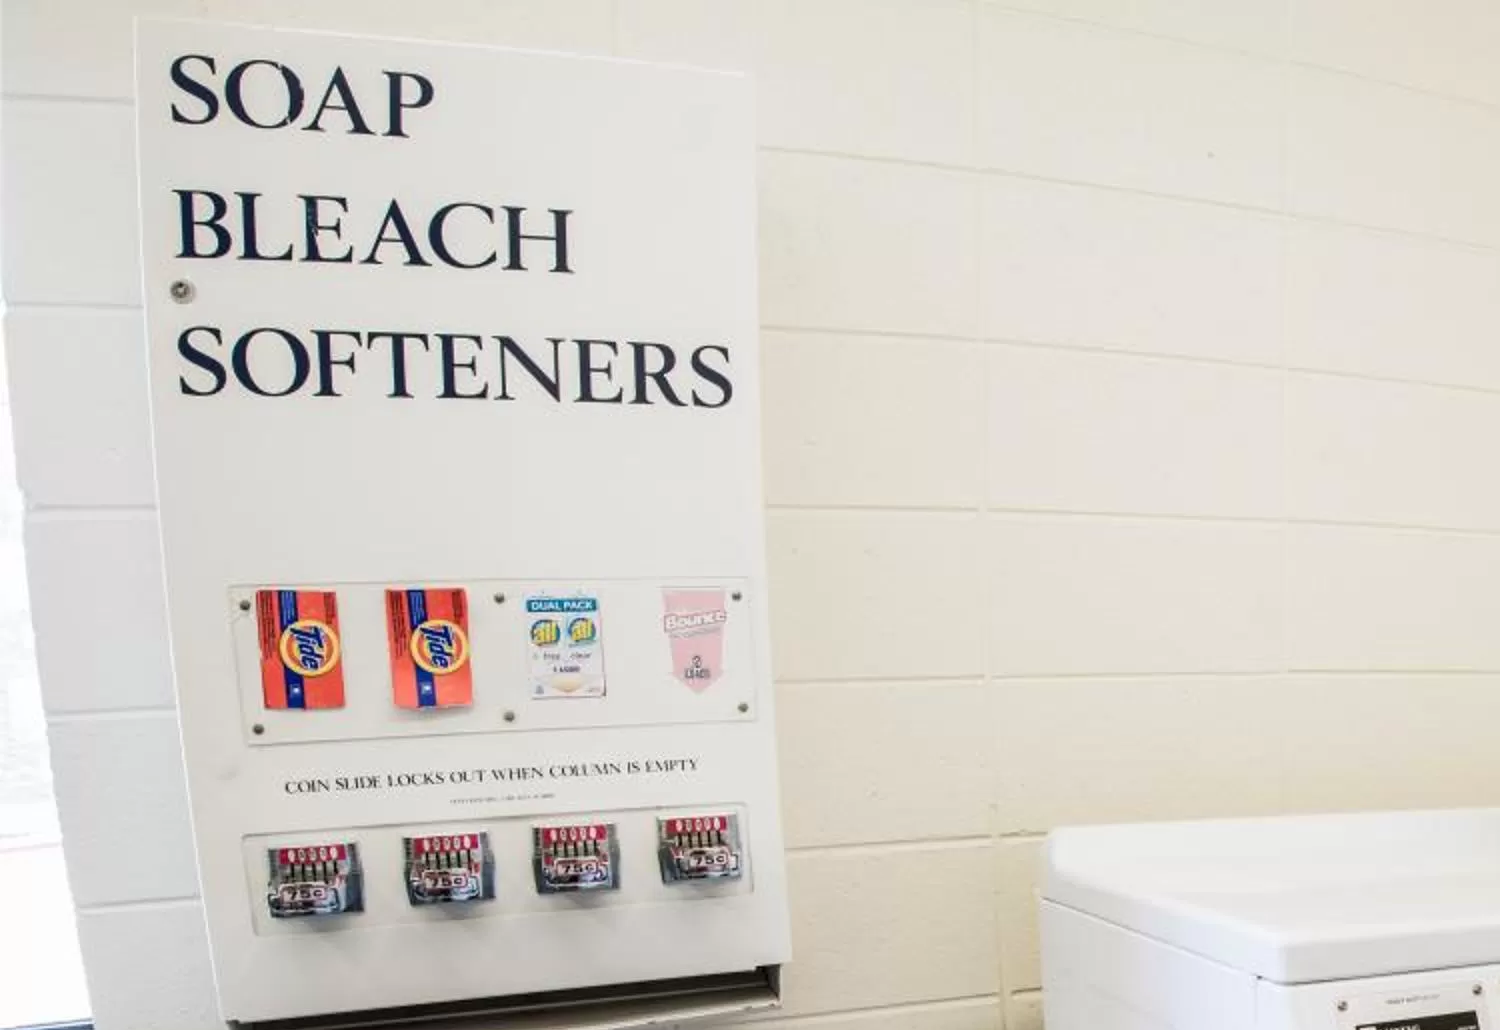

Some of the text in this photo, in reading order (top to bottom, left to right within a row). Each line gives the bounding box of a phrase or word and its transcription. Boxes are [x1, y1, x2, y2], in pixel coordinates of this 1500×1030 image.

[169, 54, 436, 138] SOAP
[171, 187, 575, 274] BLEACH
[176, 325, 734, 409] SOFTENERS
[531, 600, 593, 611] DUAL PACK
[289, 625, 324, 670] Tide
[420, 624, 454, 669] Tide
[284, 758, 699, 795] COIN SLIDE LOCKS OUT WHEN COLUMN IS EMPTY
